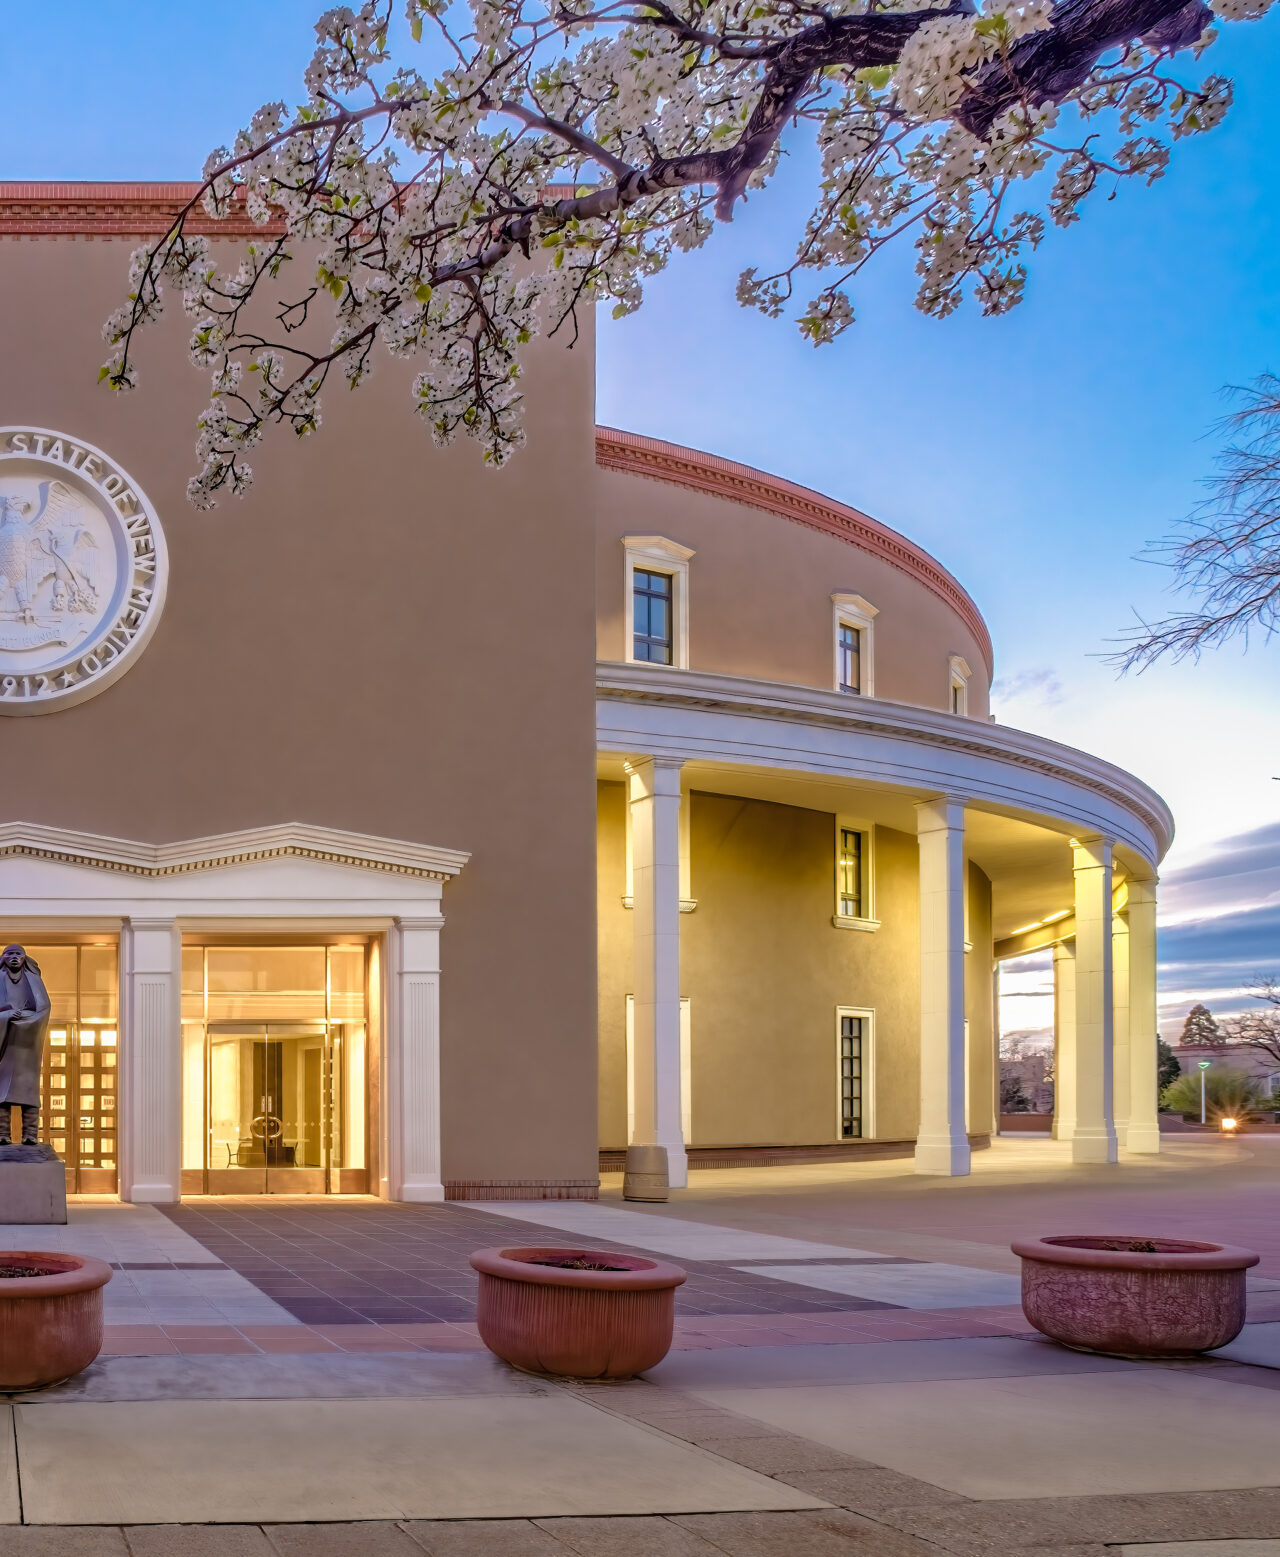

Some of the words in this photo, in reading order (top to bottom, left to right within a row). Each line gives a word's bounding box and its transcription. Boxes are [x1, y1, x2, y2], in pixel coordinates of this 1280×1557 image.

[11, 433, 104, 478] STATE
[101, 473, 138, 517] OF
[125, 511, 156, 575] NEW
[80, 585, 153, 676] MEXICO
